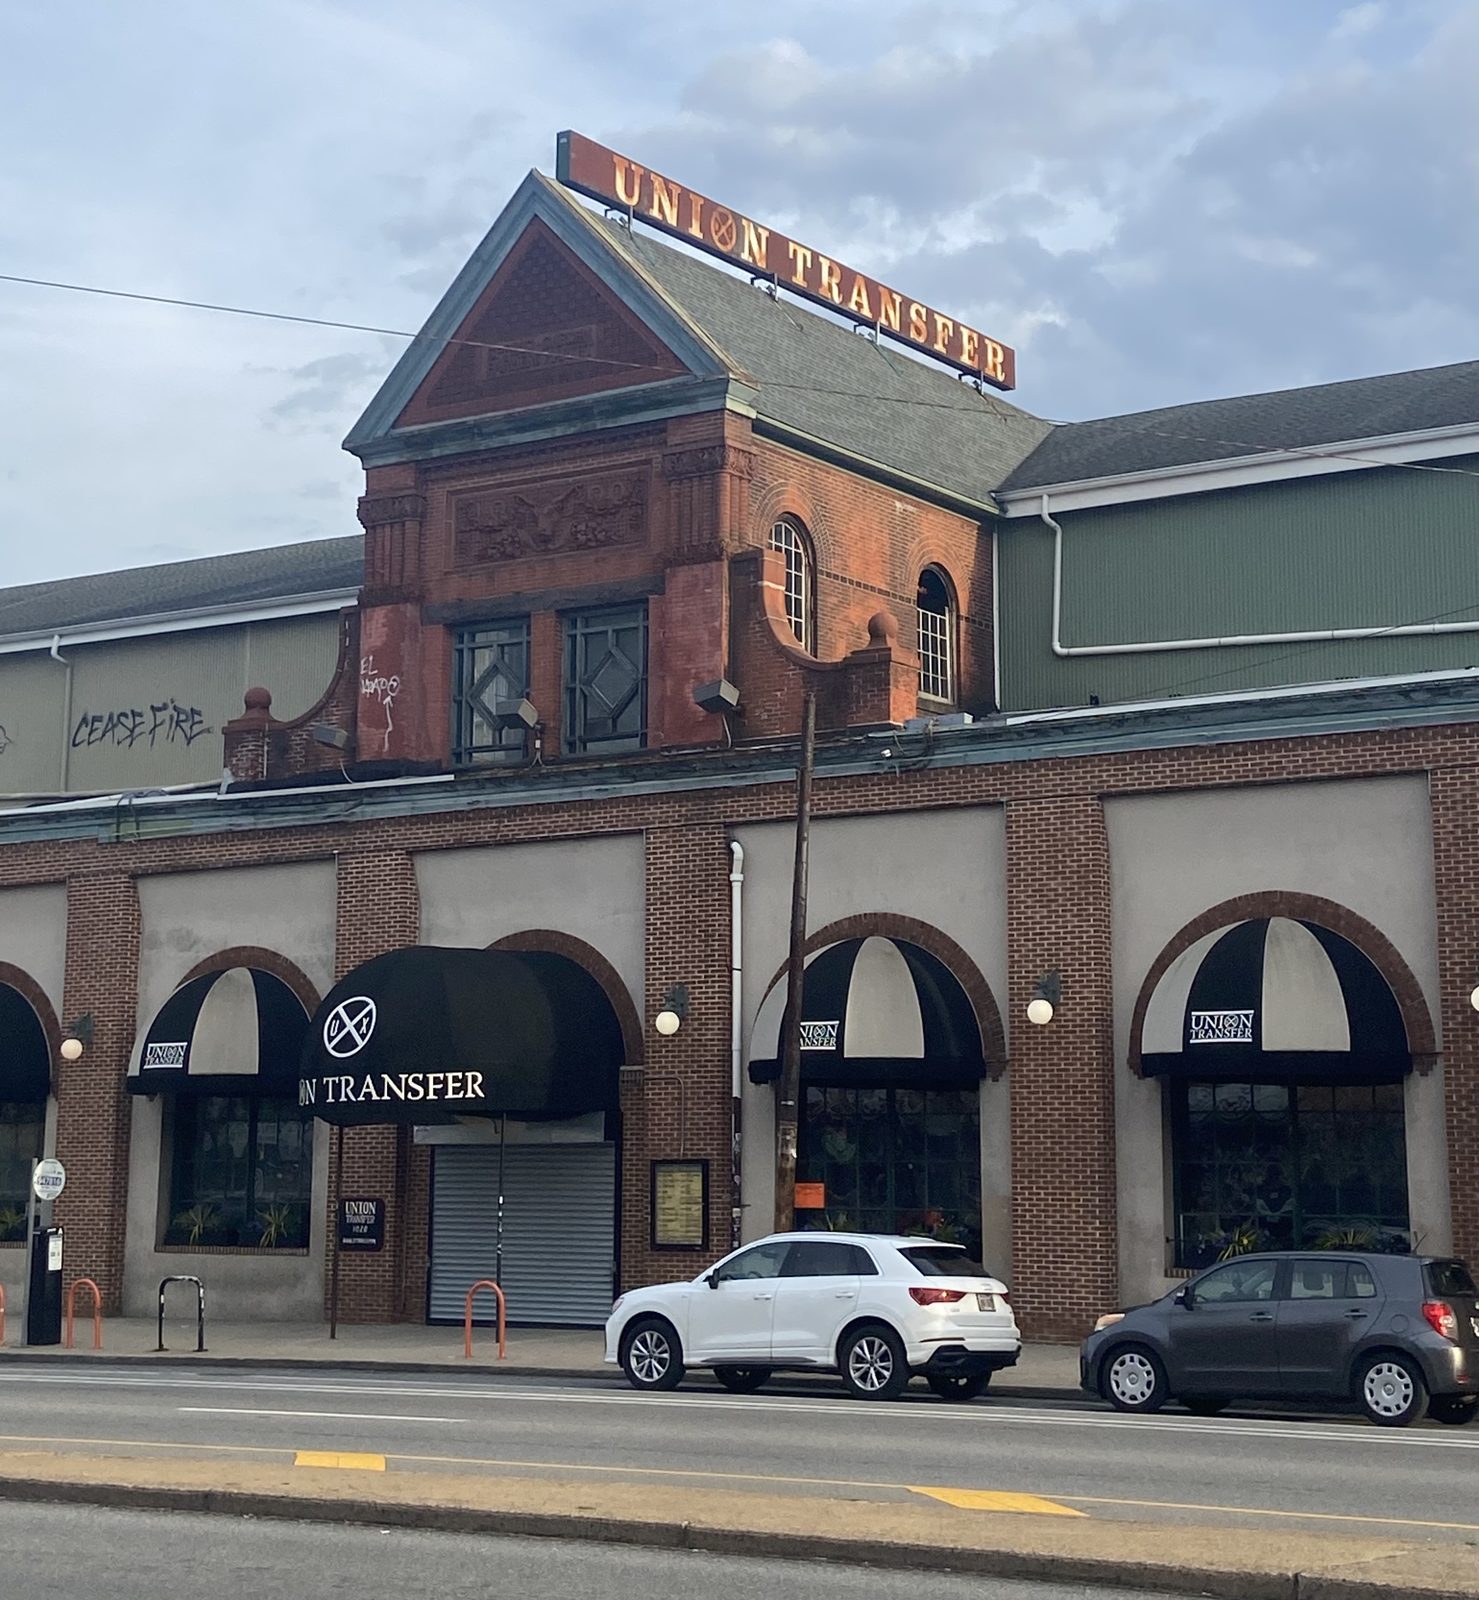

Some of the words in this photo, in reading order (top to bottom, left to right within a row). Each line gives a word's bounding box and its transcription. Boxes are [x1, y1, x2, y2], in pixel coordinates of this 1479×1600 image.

[612, 154, 770, 269] UNION
[788, 241, 1006, 382] TRANSFER
[360, 655, 378, 675] EL
[72, 709, 146, 748] CEASE
[1191, 1014, 1253, 1029] UNION
[800, 1024, 838, 1037] NION
[1189, 1028, 1252, 1039] TRANSFER
[147, 1045, 185, 1057] UNION
[145, 1056, 183, 1065] TRANSFER
[323, 1071, 485, 1104] TRANSFER
[345, 1201, 376, 1214] UNION
[345, 1214, 375, 1224] TRANSFER
